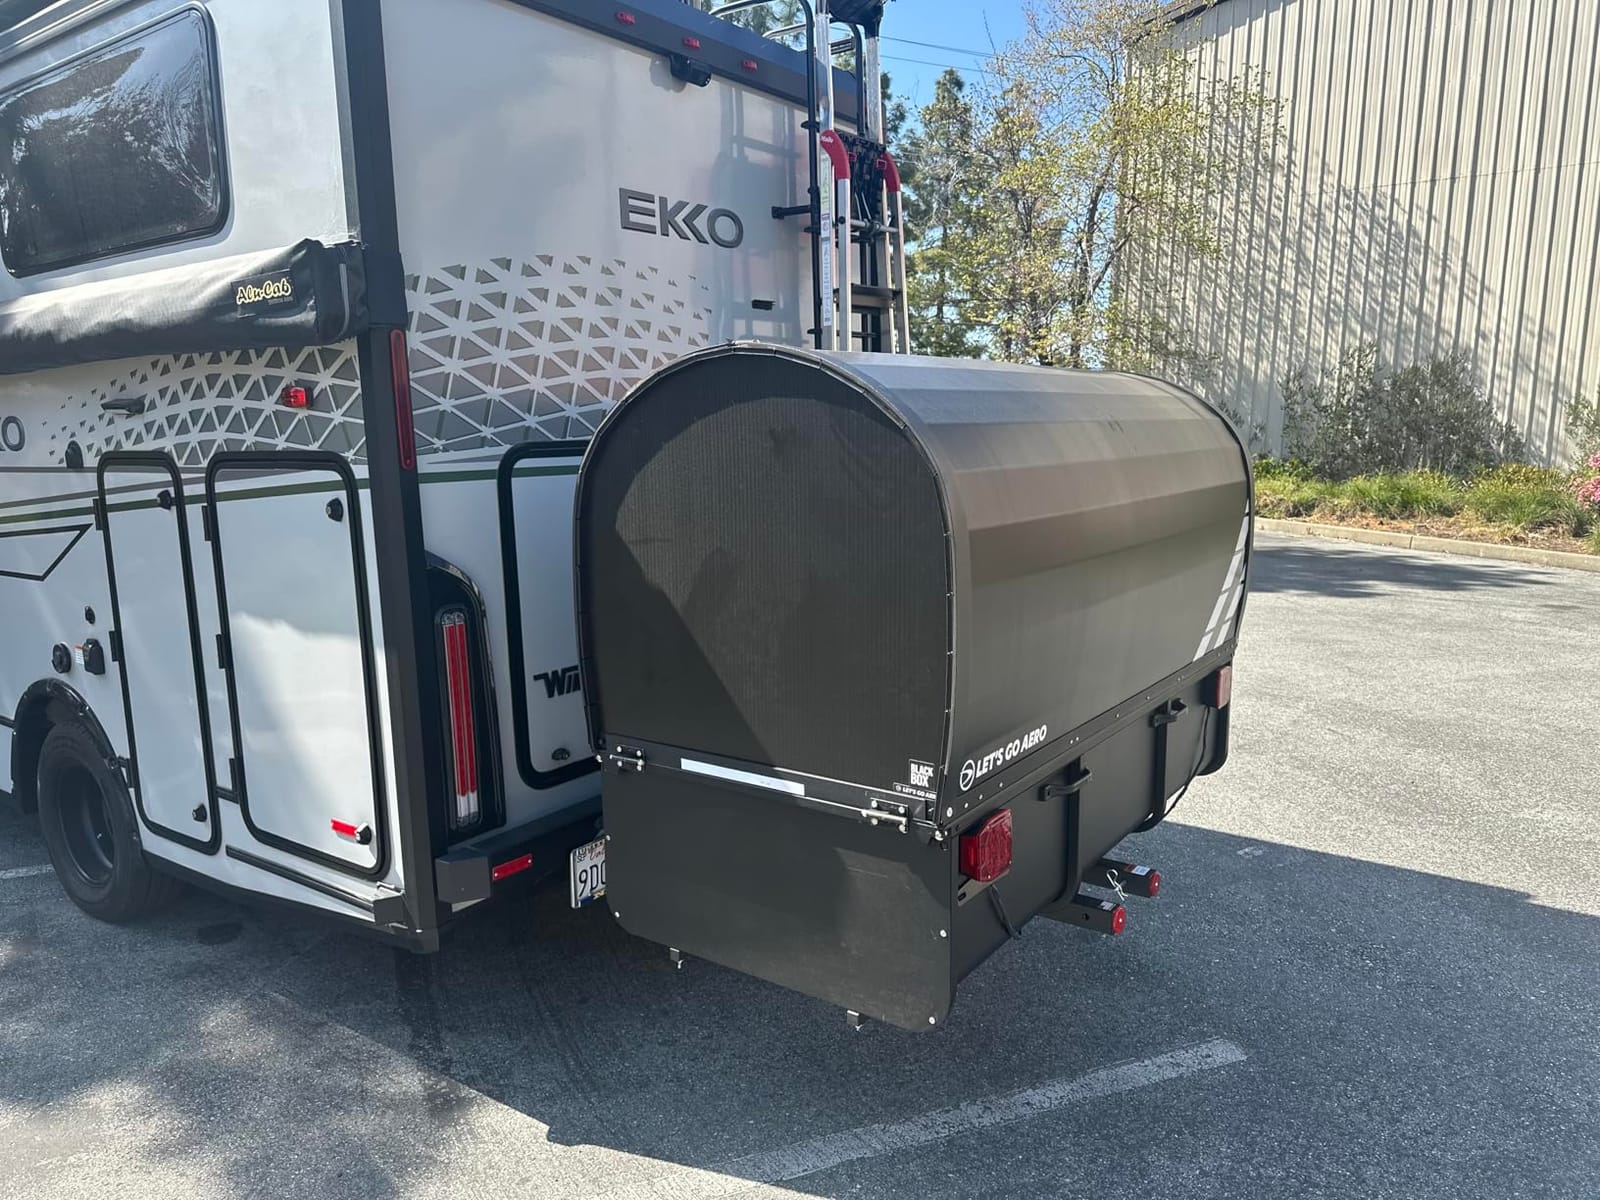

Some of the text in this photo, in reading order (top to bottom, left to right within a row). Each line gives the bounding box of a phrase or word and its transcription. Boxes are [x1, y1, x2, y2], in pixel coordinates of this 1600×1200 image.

[619, 187, 744, 249] EKKO
[975, 724, 1047, 778] LET'S GO AERO
[910, 763, 934, 777] BLACK
[910, 773, 929, 788] BOX
